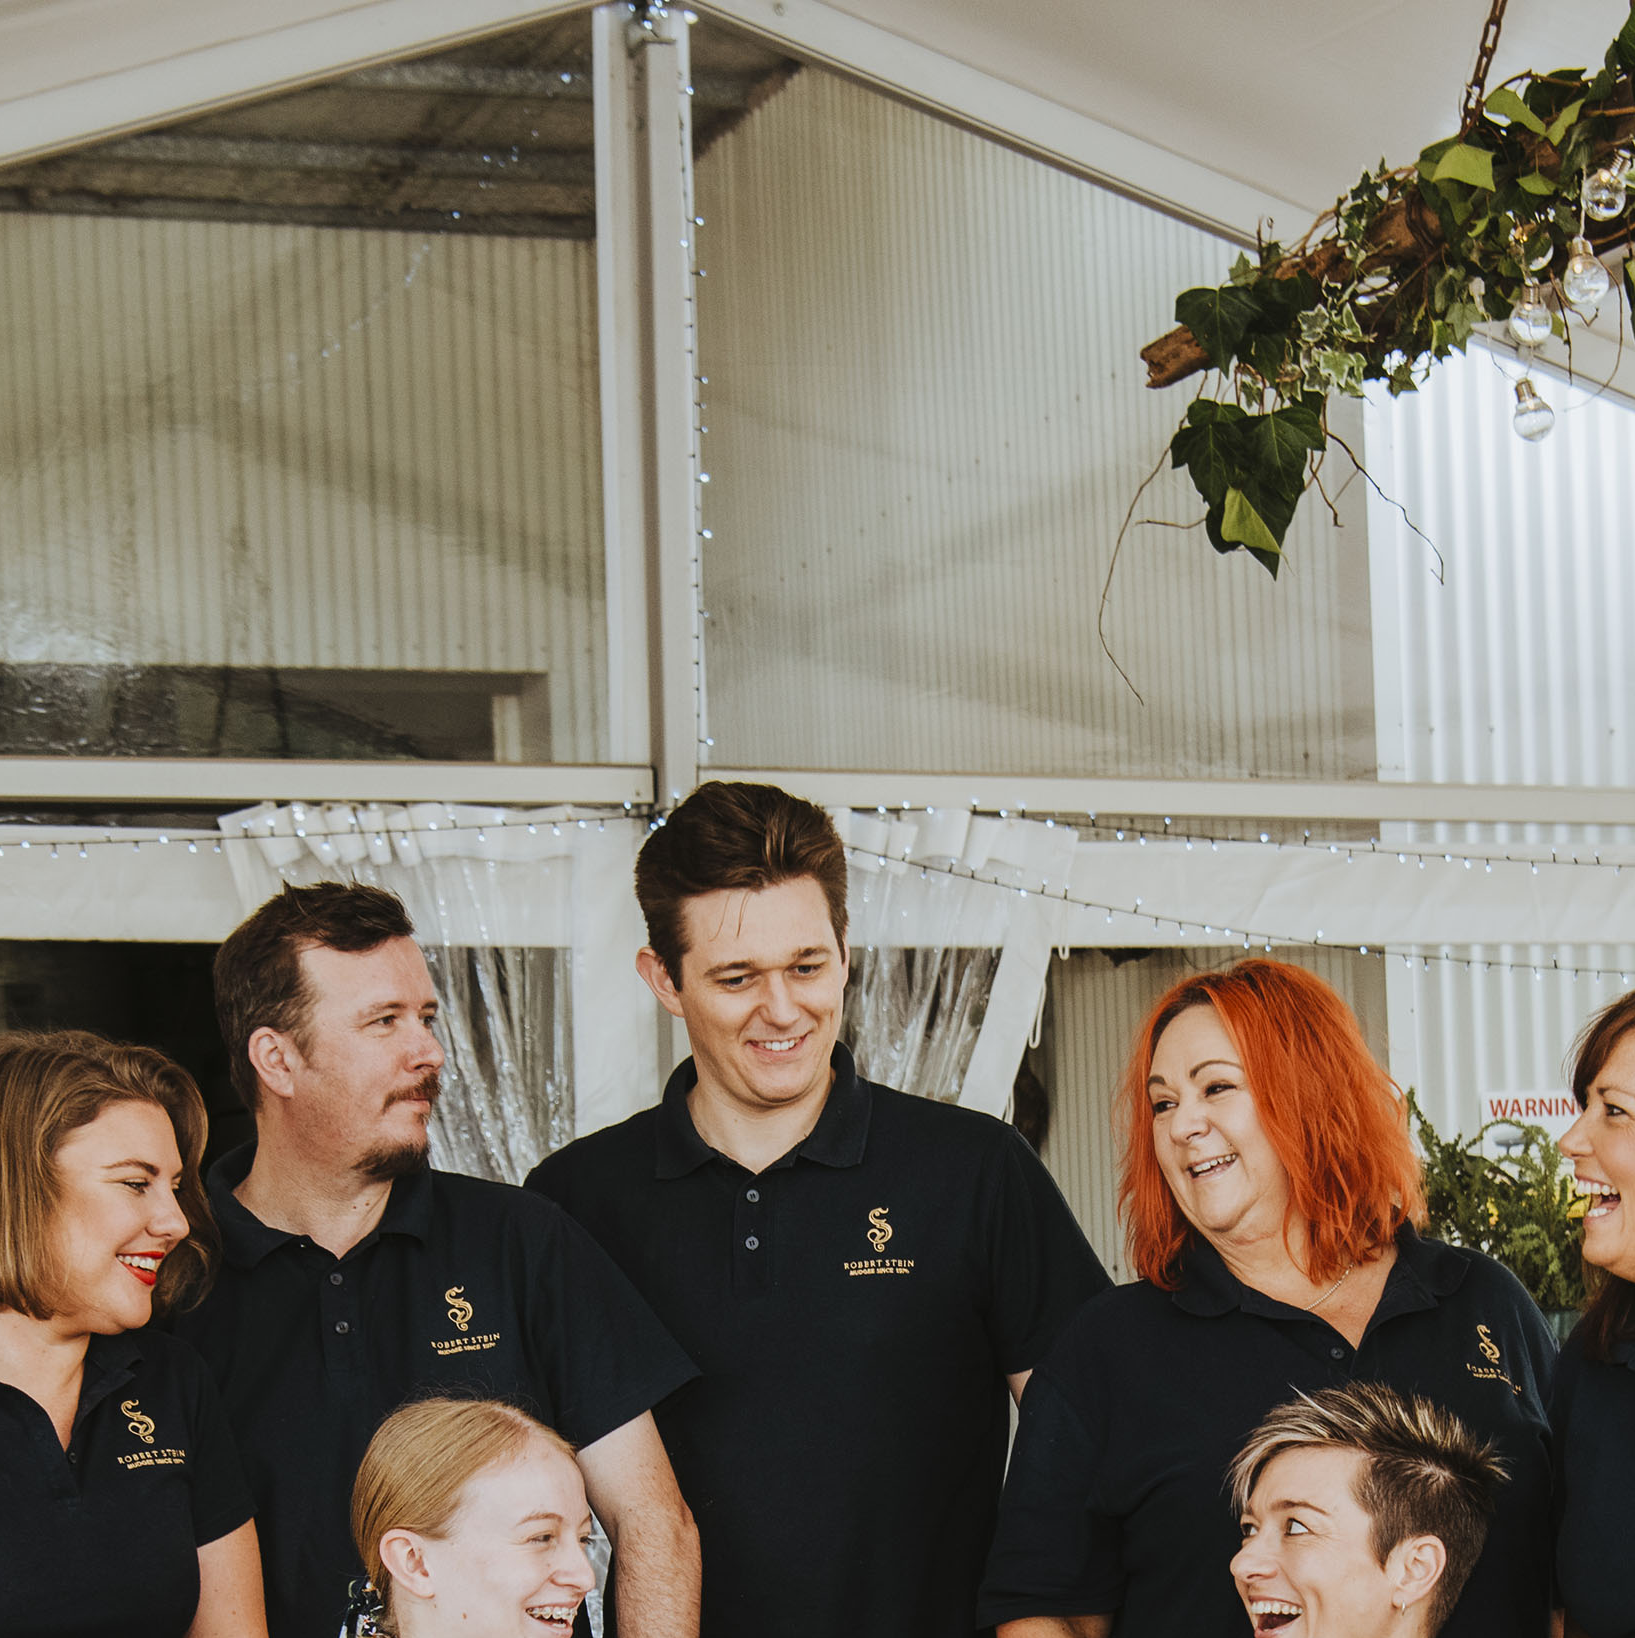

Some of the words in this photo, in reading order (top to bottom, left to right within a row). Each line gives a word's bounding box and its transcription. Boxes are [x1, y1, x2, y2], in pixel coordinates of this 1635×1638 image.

[843, 1259, 883, 1270] ROBERT
[885, 1258, 915, 1268] STEIN
[430, 1337, 469, 1349] ROBERT
[471, 1333, 501, 1344] STEIN
[117, 1450, 159, 1465] ROBERT
[161, 1448, 187, 1458] STEIN
